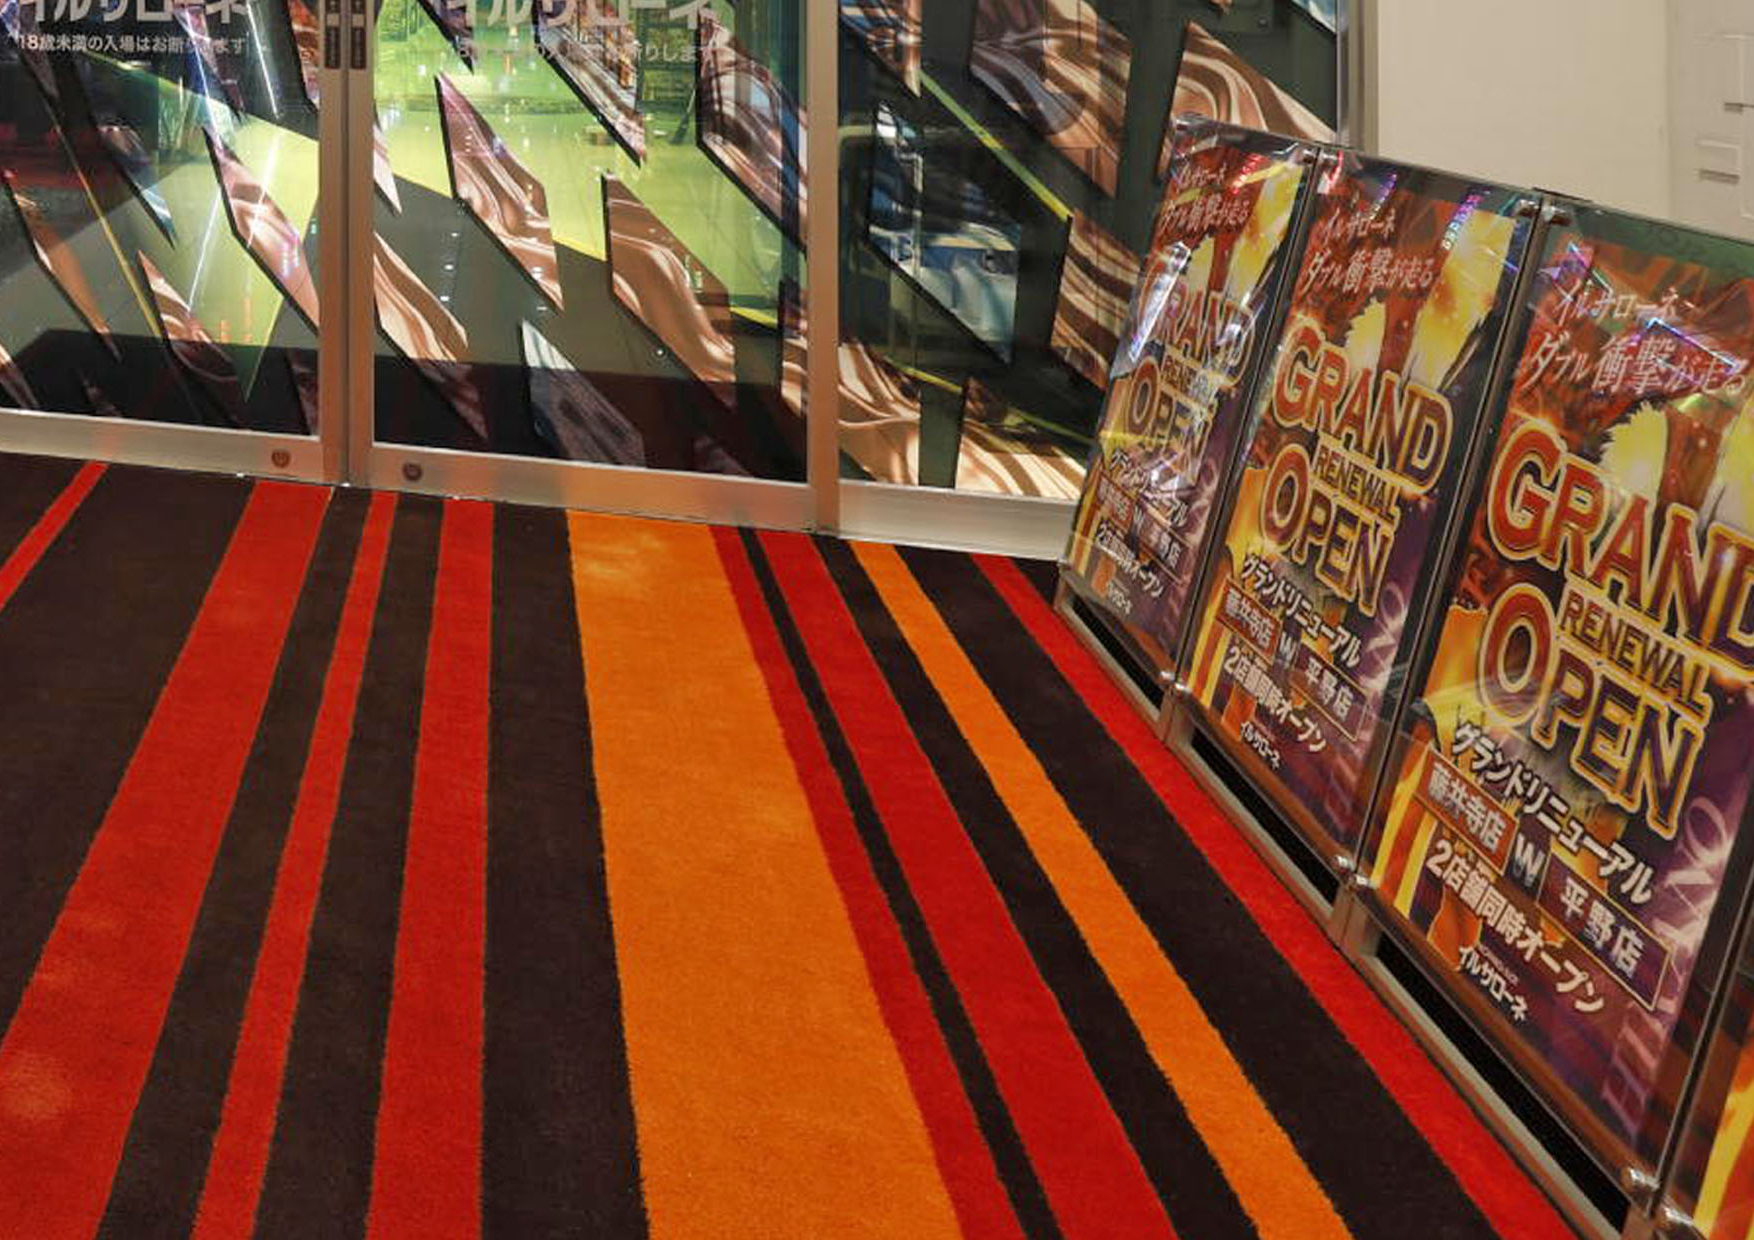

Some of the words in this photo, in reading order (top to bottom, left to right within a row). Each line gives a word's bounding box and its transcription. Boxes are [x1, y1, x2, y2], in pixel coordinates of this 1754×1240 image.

[17, 33, 247, 55] 18歳未満の入場はお断ます
[1272, 313, 1454, 495] GRAND
[1261, 442, 1397, 618] OPEN
[1312, 443, 1398, 525] RENEWAL
[1240, 553, 1363, 668] グランドリニューアル
[1557, 588, 1712, 723] RENEWAL
[1477, 582, 1706, 840] OPEN
[1452, 723, 1655, 905] グランドリニューアル
[1424, 839, 1604, 1013] 2店舗同時オープン
[1511, 831, 1547, 888] W
[1560, 876, 1646, 980] 平野店
[1458, 945, 1529, 1022] イルサローネ
